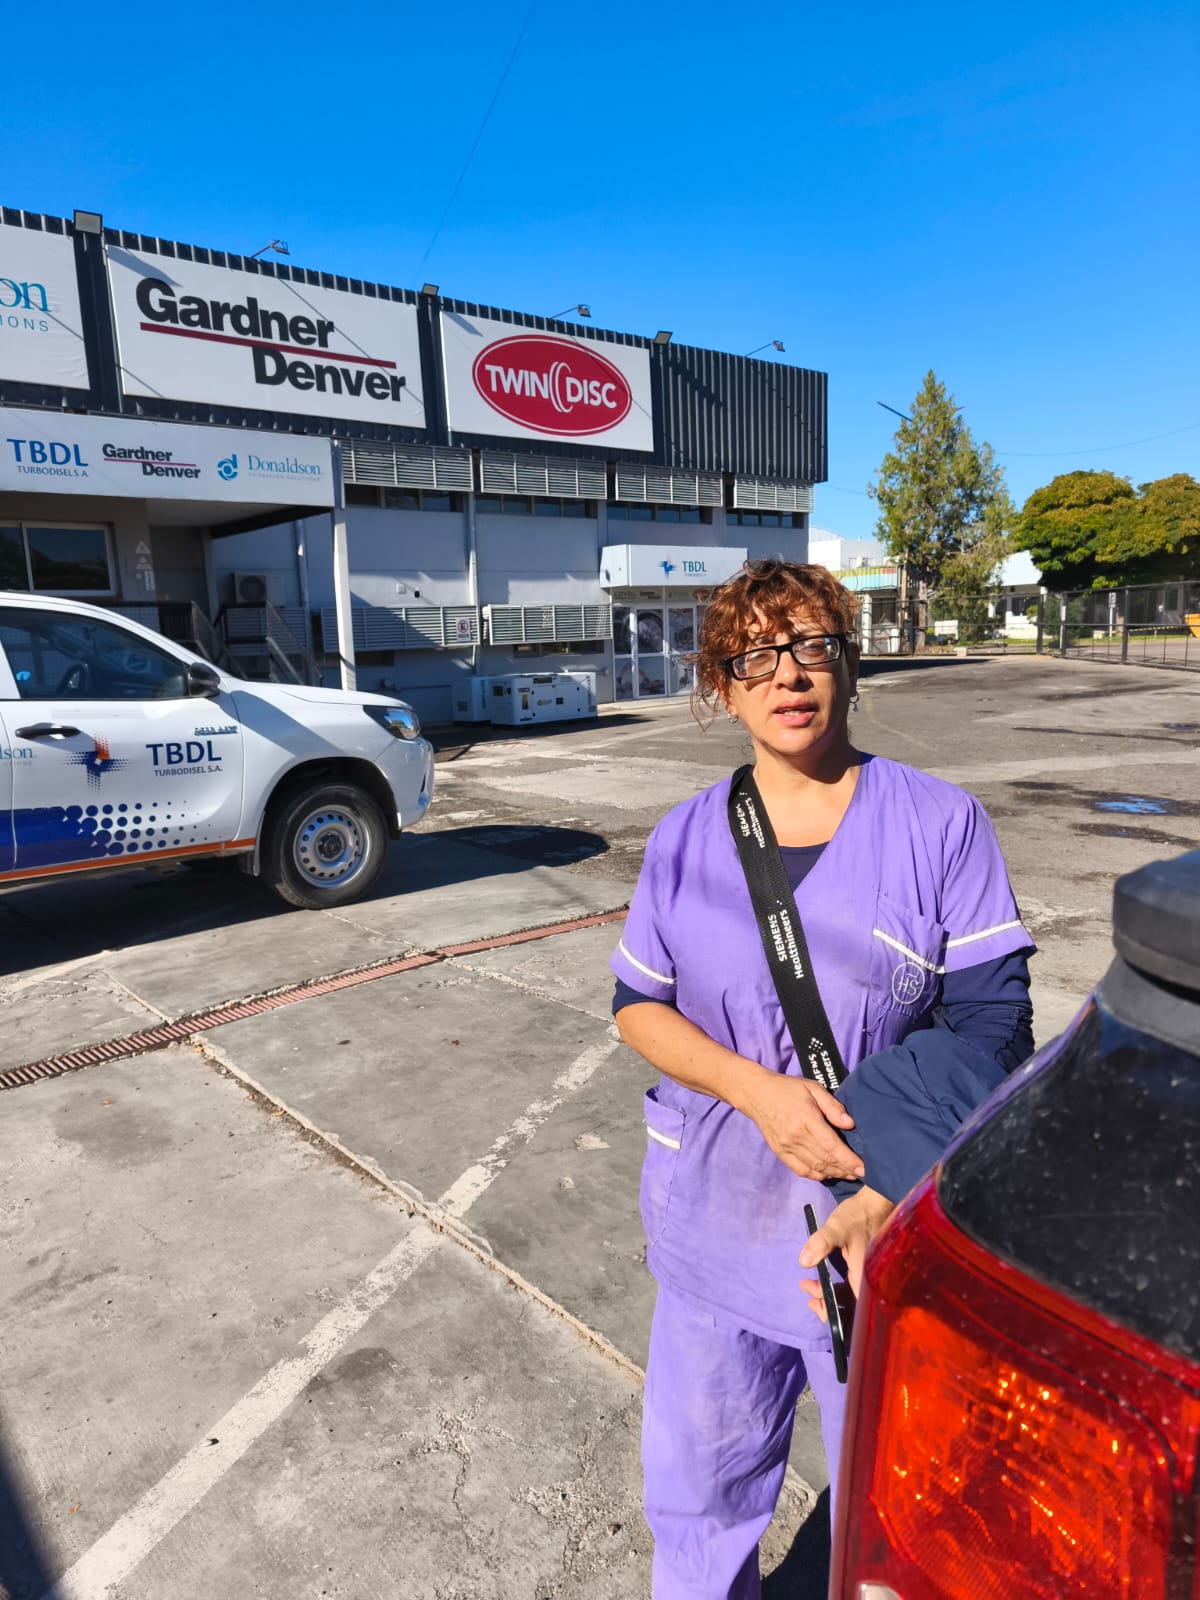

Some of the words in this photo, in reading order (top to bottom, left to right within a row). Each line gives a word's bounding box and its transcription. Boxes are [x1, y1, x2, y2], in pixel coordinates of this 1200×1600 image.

[136, 277, 334, 348] Gardner
[252, 345, 406, 402] Denver
[485, 364, 549, 399] TWIN
[565, 376, 617, 409] DISC
[6, 438, 88, 467] TBDL
[102, 443, 173, 462] Gardner
[247, 454, 321, 475] Donaldson
[16, 465, 73, 477] TURBODISEL
[142, 463, 201, 479] Denver
[682, 560, 707, 573] TBDL
[145, 741, 222, 766] TBDL
[154, 766, 206, 777] TURBODISEL
[767, 913, 788, 962] SIEMENS
[780, 909, 805, 979] Healthineers
